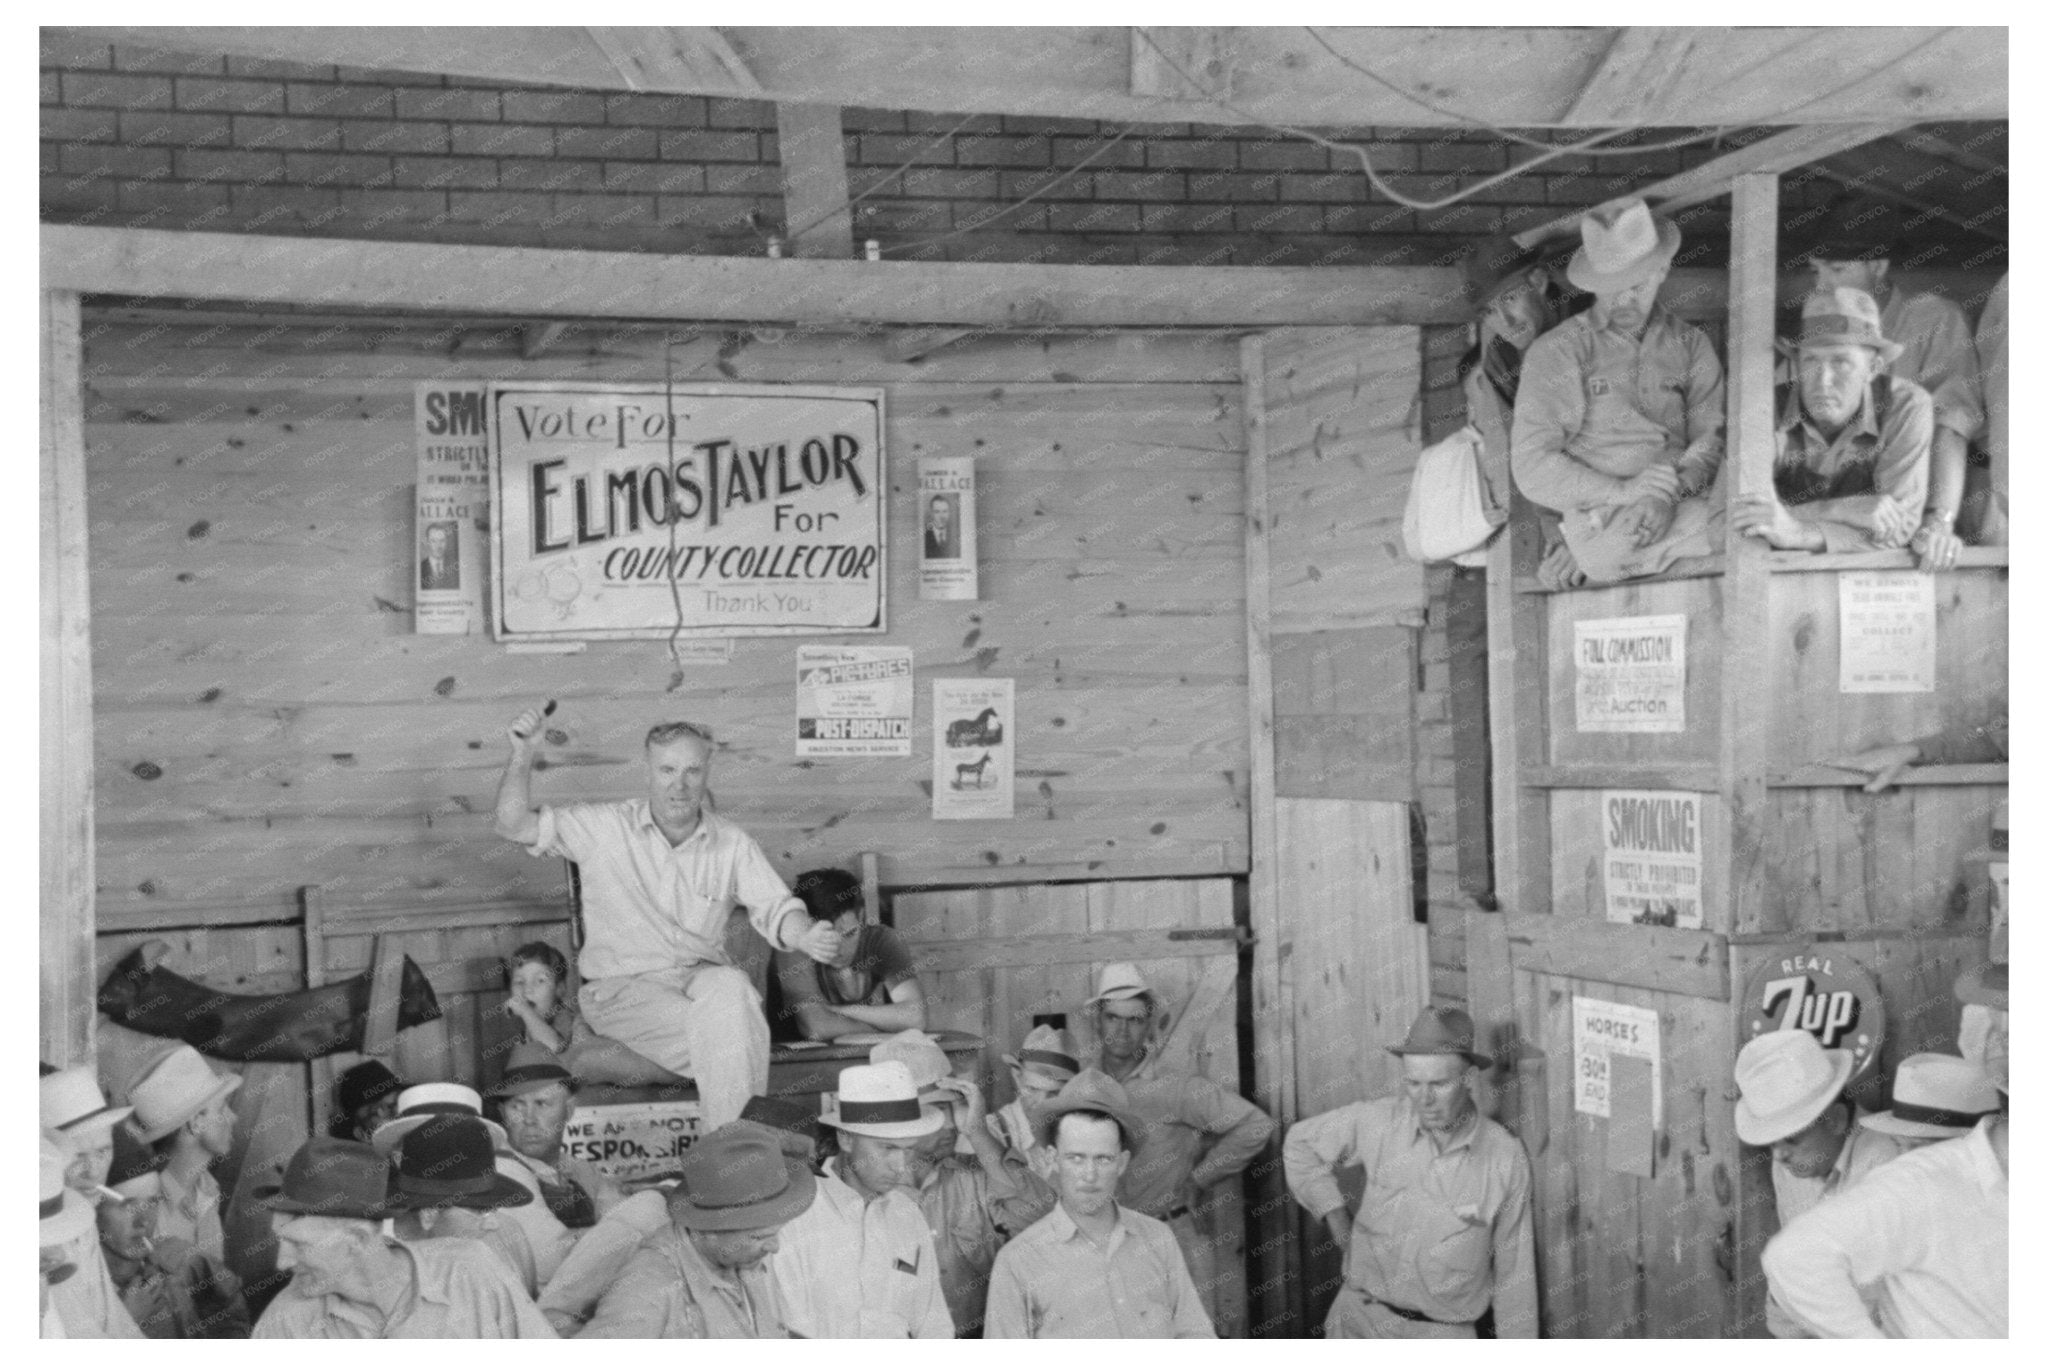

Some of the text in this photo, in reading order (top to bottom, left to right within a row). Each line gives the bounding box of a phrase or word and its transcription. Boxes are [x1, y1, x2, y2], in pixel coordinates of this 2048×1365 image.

[515, 405, 691, 449] Vote For
[692, 432, 867, 528] TAYLOR
[775, 504, 840, 533] For
[604, 545, 877, 580] COUNTY COLLECTOR
[704, 591, 812, 614] Thank You
[831, 658, 909, 683] PICTURES
[1611, 697, 1667, 714] Auction
[816, 719, 909, 739] POST-DISPATCH
[1608, 798, 1695, 853] SMOKING
[1610, 861, 1643, 881] STRICTLY
[1781, 955, 1834, 977] REAL
[1586, 1016, 1639, 1044] HORSES
[567, 1124, 595, 1138] WE
